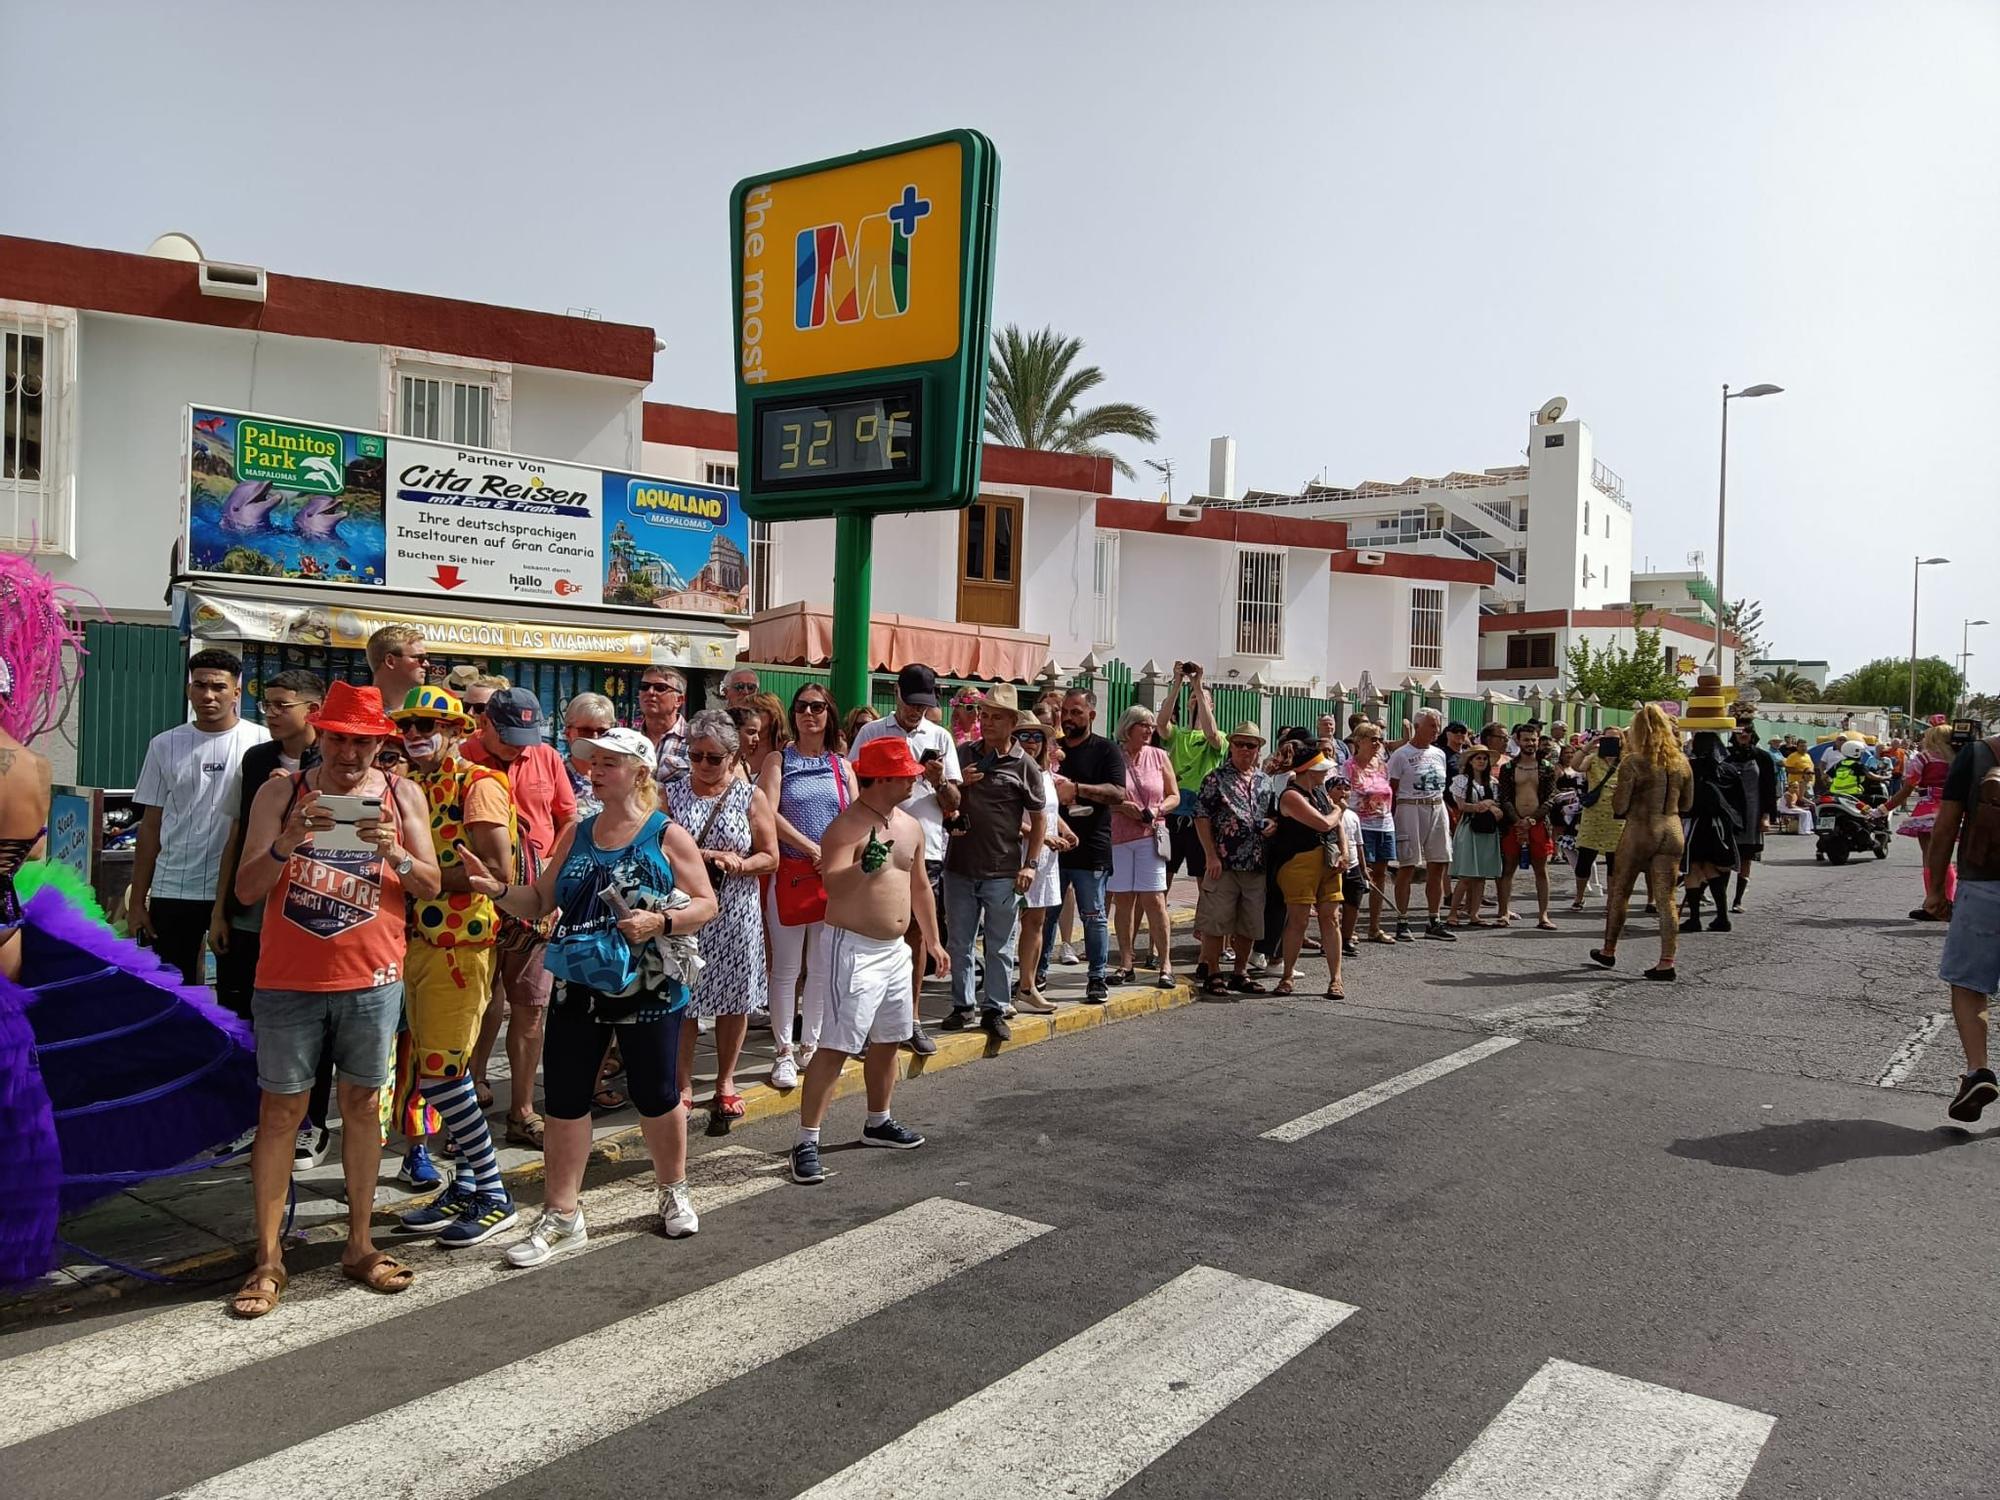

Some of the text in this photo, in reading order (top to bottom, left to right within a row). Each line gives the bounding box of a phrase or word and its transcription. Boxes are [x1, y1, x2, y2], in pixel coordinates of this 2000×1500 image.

[743, 185, 772, 384] the most
[244, 426, 336, 456] Palmitos
[779, 424, 832, 469] 32
[243, 445, 297, 470] Park
[457, 452, 546, 474] Partner Von
[245, 468, 297, 481] MASPALOMAS
[399, 464, 588, 506] Cita Reisen
[428, 494, 558, 515] mit Eva & Frank
[636, 488, 722, 518] AQUALAND
[418, 511, 577, 542] Ihre deutschsprachigen
[650, 514, 707, 529] MASPALOMAS
[396, 526, 594, 559] Inseltouren auf Gran Canaria
[398, 549, 496, 567] Buchen Sie hier
[509, 573, 543, 587] hallo
[511, 629, 544, 649] LAS
[550, 632, 625, 653] MARINAS
[289, 854, 381, 911] EXPLORE
